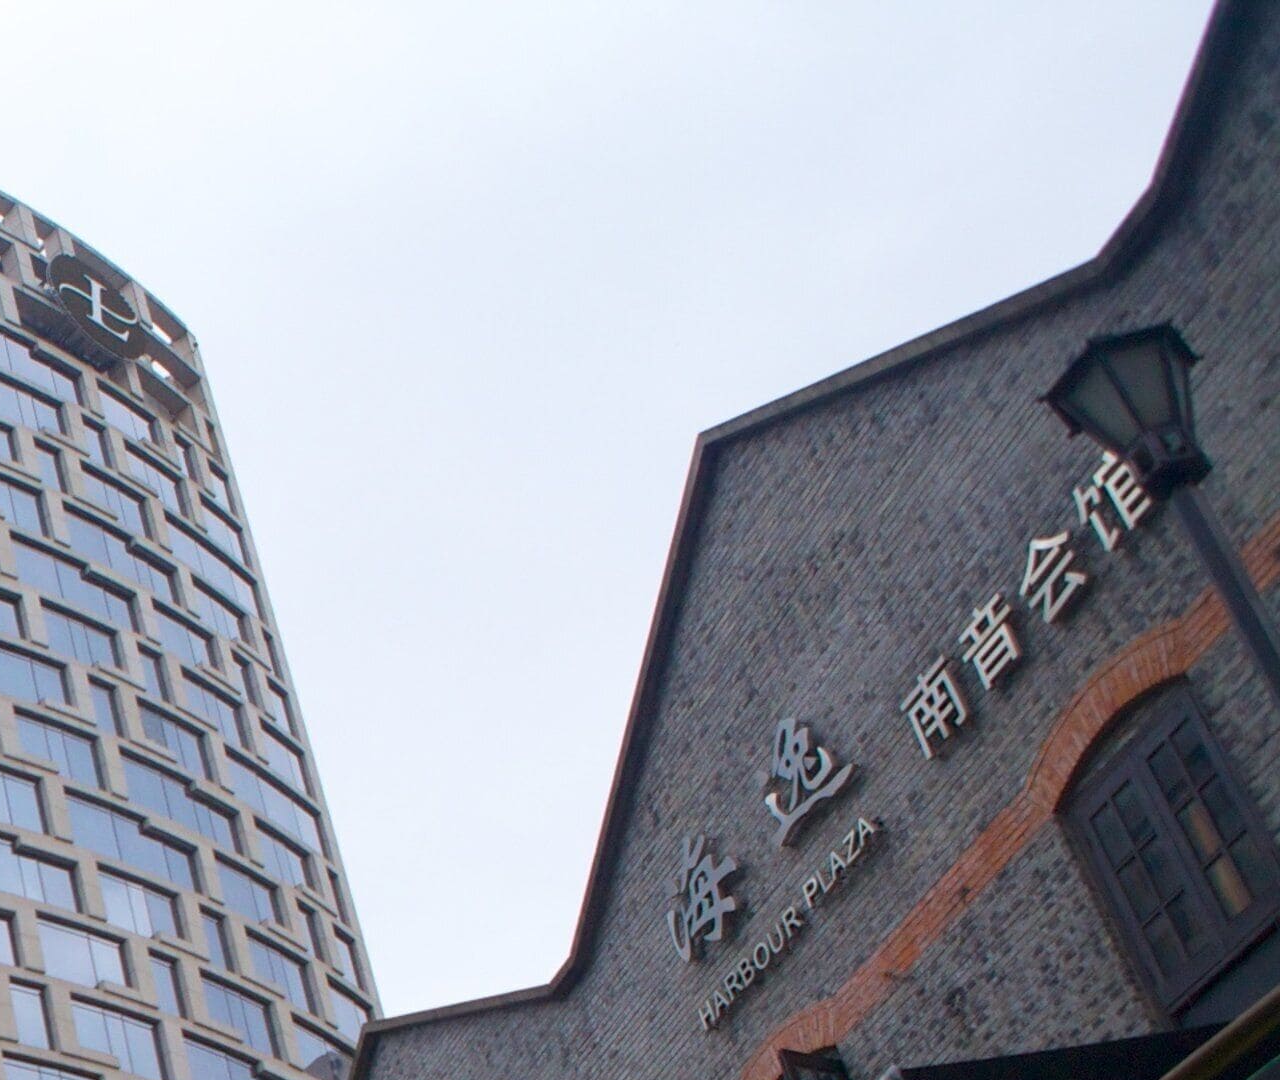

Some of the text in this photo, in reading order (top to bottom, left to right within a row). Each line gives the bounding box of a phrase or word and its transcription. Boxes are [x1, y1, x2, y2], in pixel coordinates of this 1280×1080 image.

[900, 450, 1154, 760] 南音会馆
[698, 816, 878, 1030] HARBOUR PLAZA
